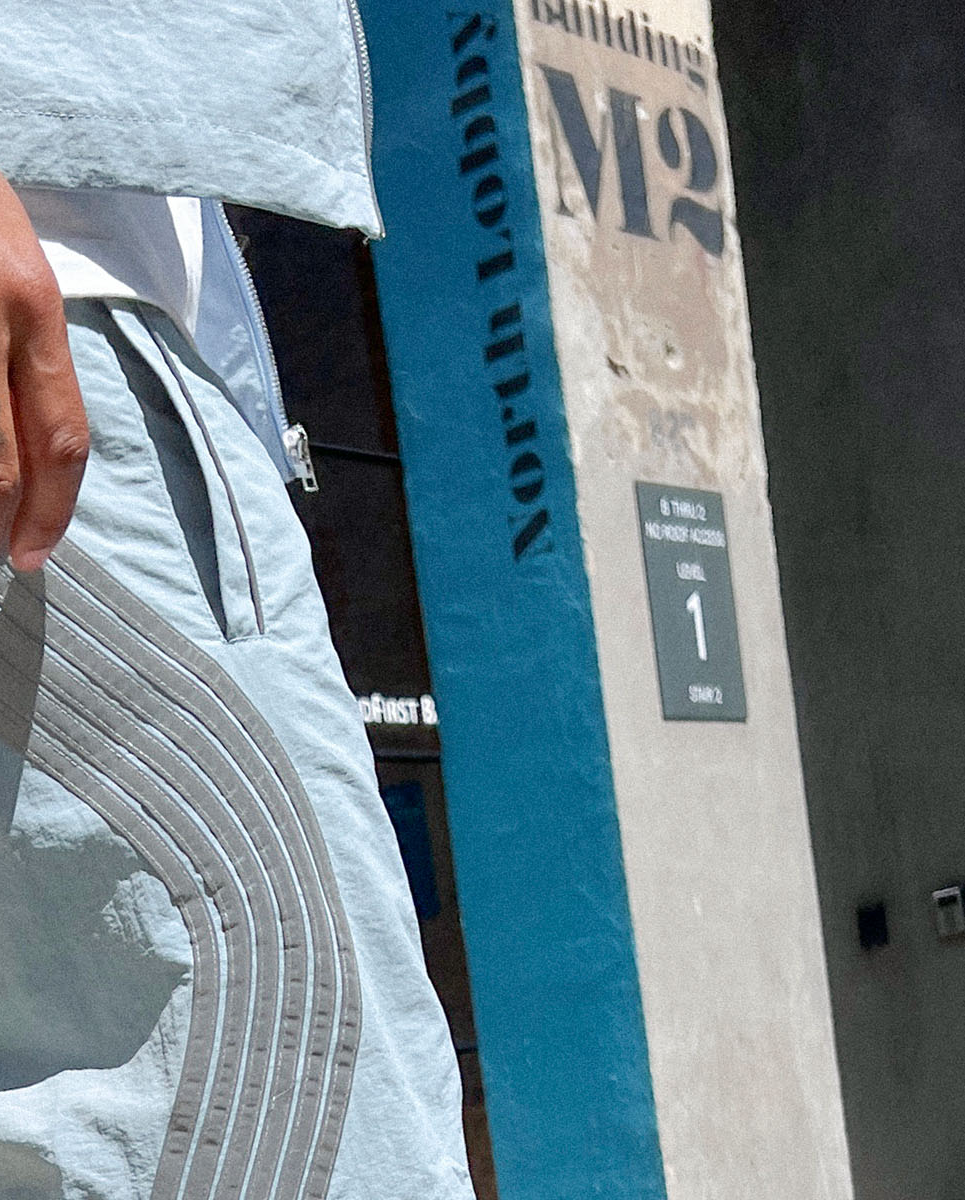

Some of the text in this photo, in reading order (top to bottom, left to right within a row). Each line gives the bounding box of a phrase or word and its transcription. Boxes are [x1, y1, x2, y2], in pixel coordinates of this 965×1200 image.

[535, 63, 725, 259] M2
[446, 8, 554, 562] North Lobby
[686, 590, 707, 661] 1
